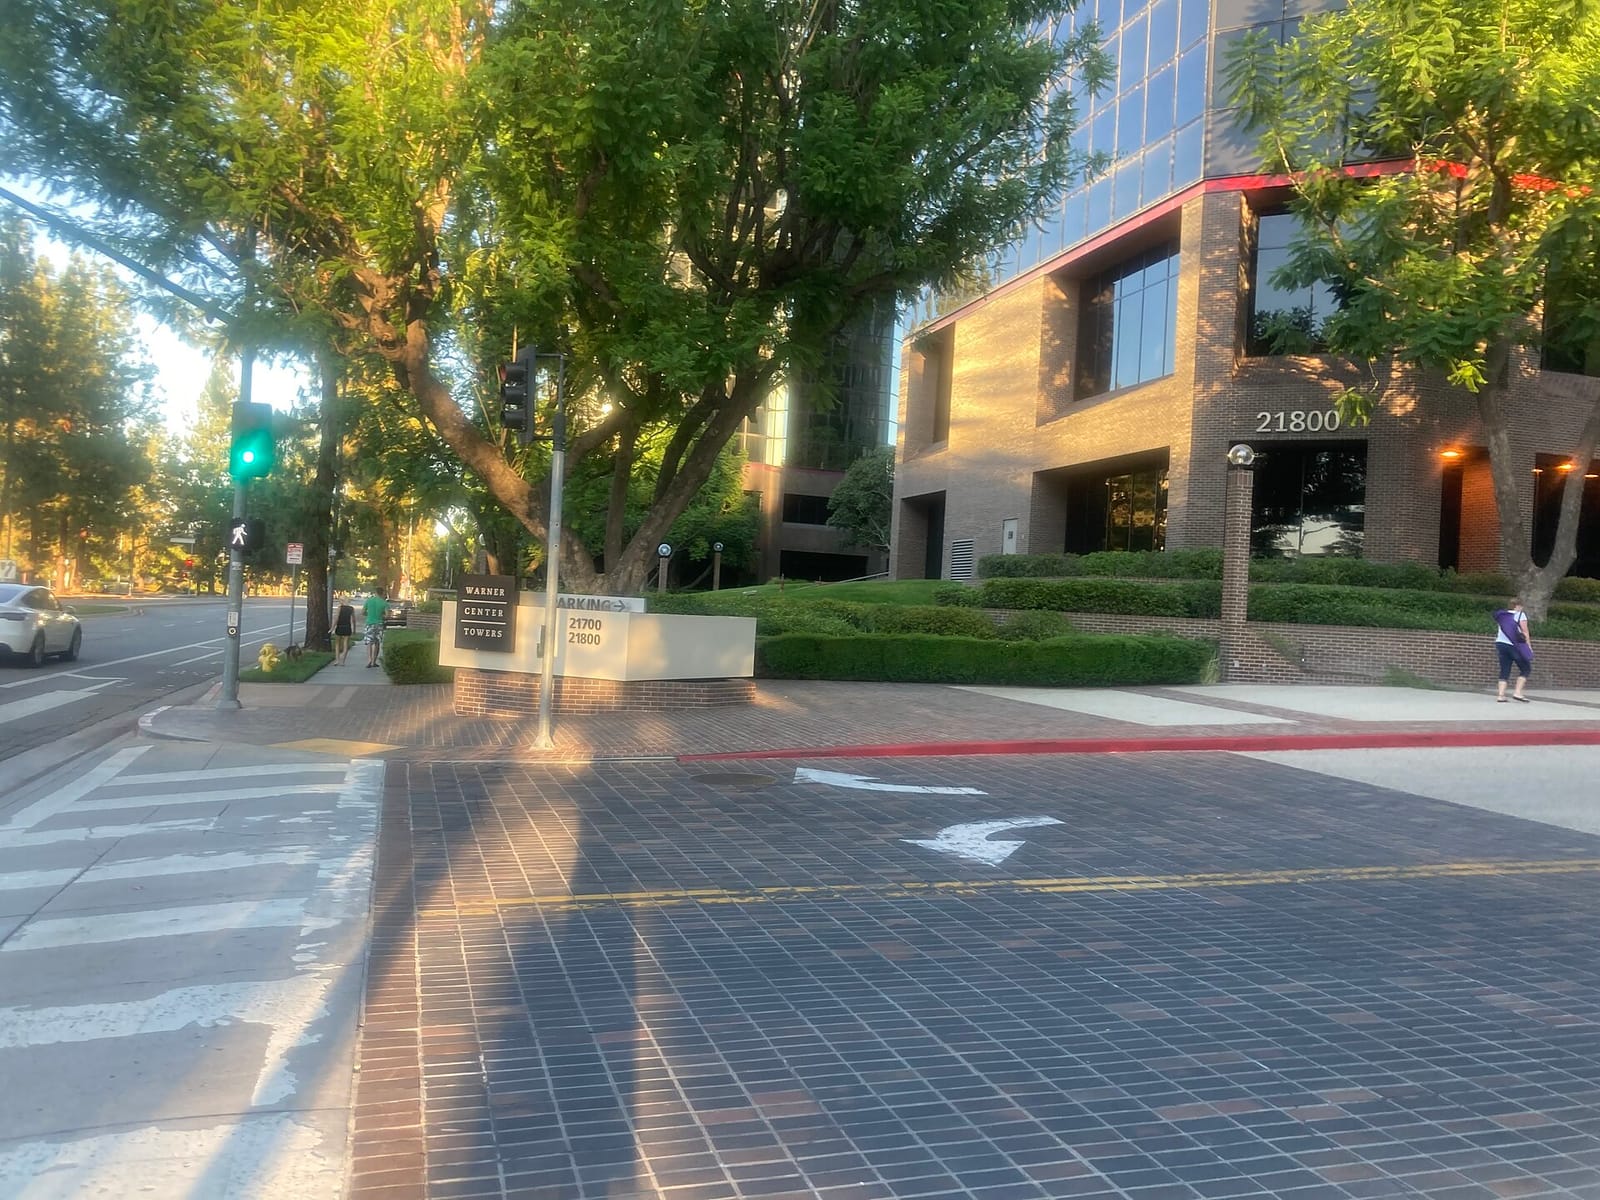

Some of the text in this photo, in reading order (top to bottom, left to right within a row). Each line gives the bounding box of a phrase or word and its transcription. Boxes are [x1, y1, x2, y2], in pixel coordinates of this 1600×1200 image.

[1256, 410, 1340, 432] 21800
[465, 586, 505, 597] WARNER
[556, 597, 611, 611] ARKING
[464, 607, 504, 617] CENTER
[569, 617, 602, 631] 21700
[463, 627, 503, 638] TOWERS
[568, 631, 601, 645] 21800
